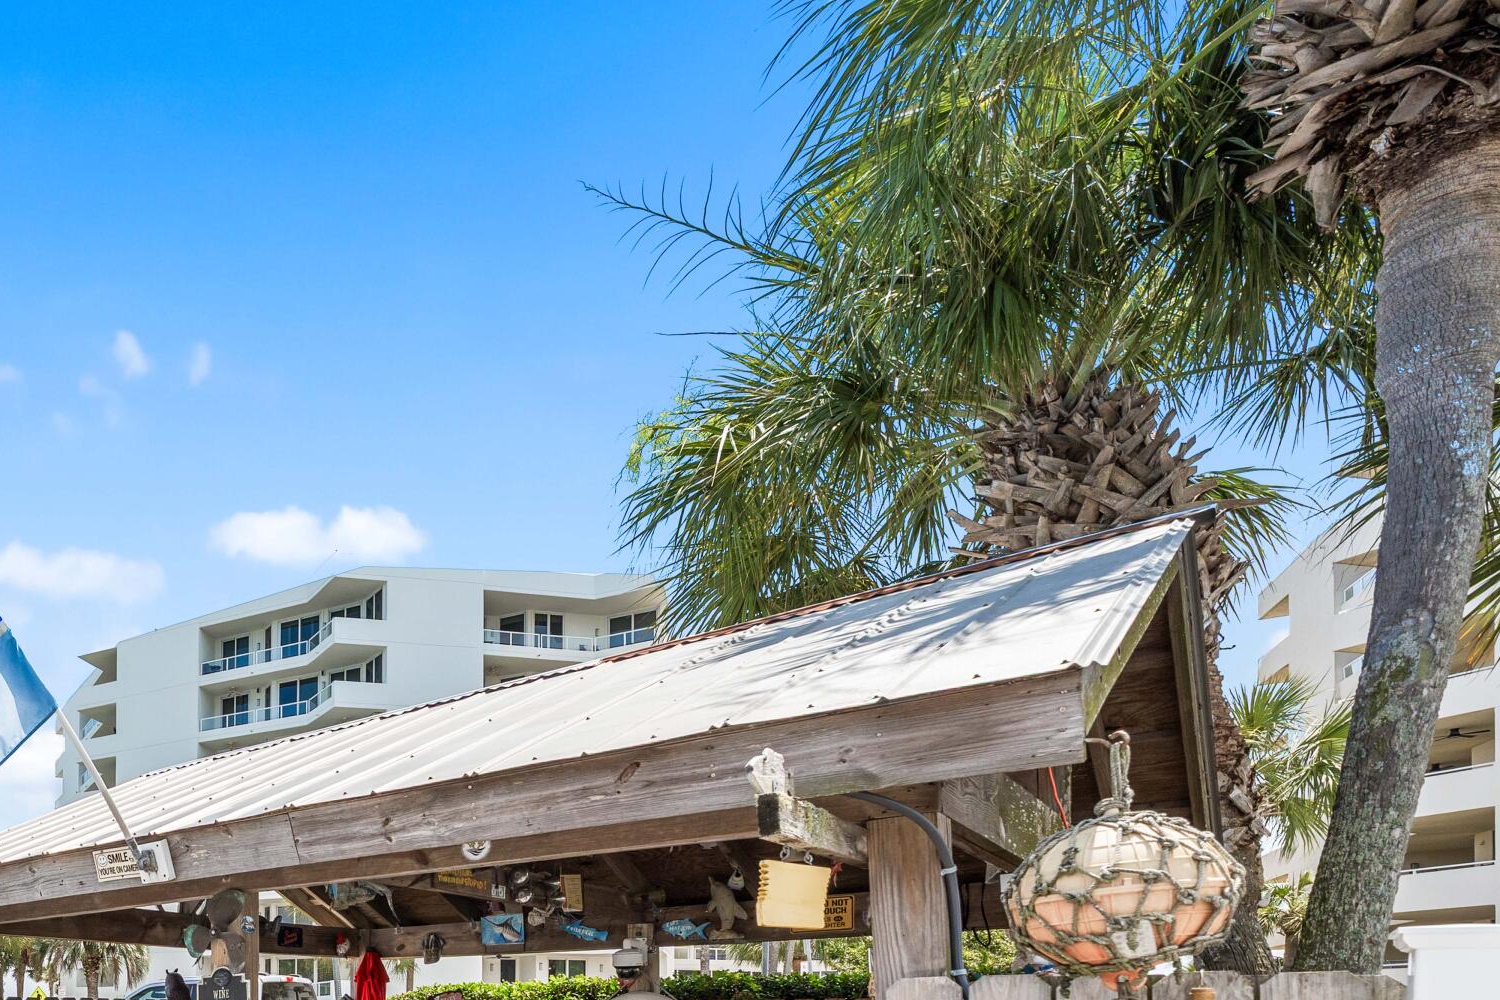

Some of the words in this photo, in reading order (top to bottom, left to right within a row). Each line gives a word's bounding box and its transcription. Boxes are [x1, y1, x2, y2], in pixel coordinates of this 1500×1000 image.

[107, 852, 129, 864] SMILE
[100, 867, 116, 876] YOU'RE
[116, 866, 123, 874] ON
[832, 899, 849, 907] NOT
[824, 907, 847, 915] OUCH
[213, 988, 230, 999] WINE
